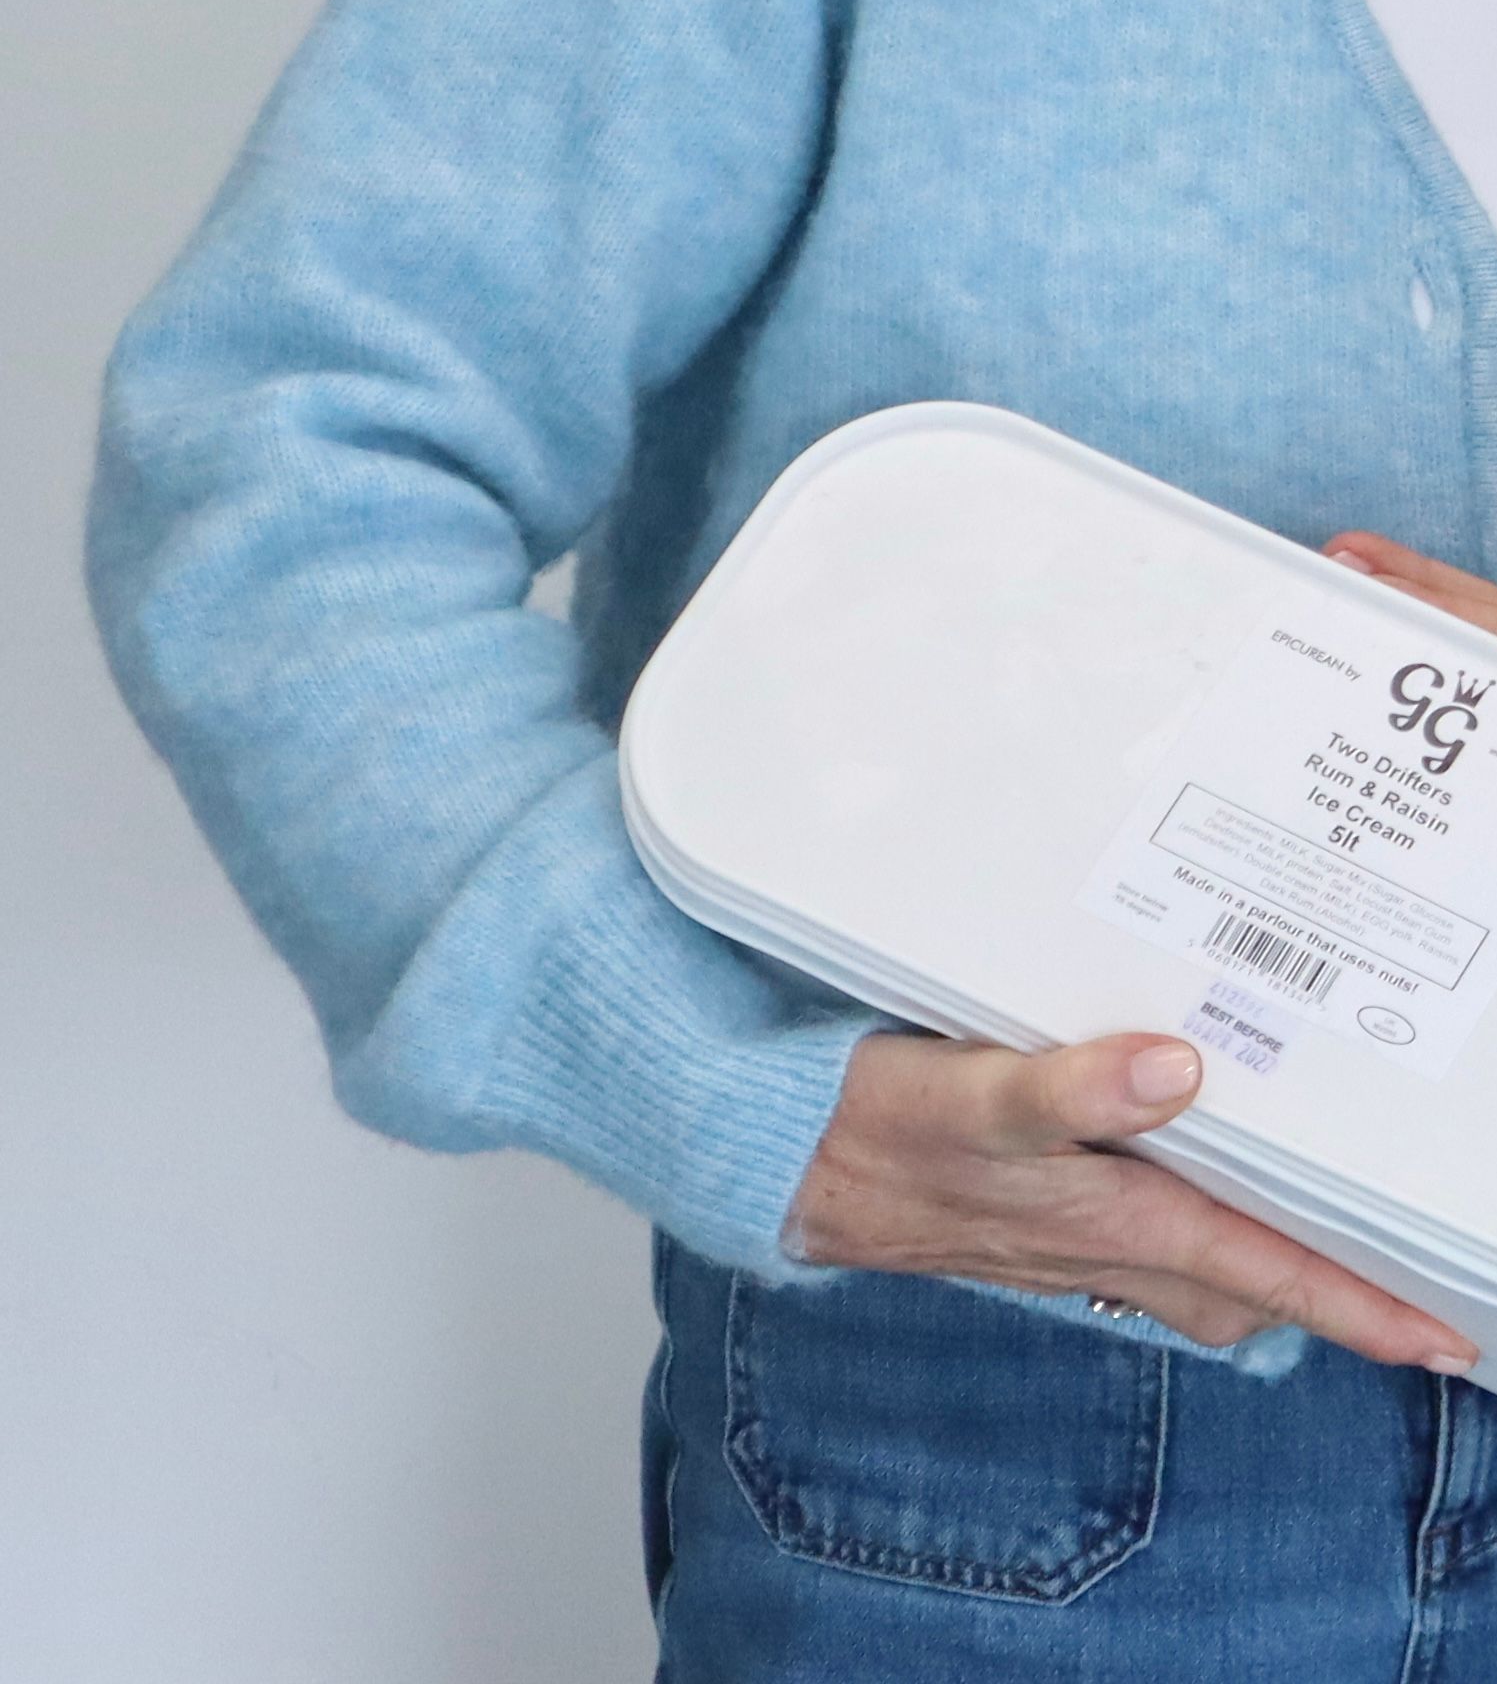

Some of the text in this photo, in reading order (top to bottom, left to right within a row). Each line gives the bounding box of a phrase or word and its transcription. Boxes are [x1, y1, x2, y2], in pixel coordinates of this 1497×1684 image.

[1270, 630, 1362, 682] EPICUREAN by
[1305, 752, 1450, 835] Rum & Raisin
[1327, 732, 1453, 806] Two Drifters
[1308, 785, 1416, 849] Ice Cream
[1327, 824, 1361, 853] 5lt
[1173, 865, 1419, 997] Made in a parlour that uses nuts!
[1200, 1002, 1284, 1054] BEST BEFORE
